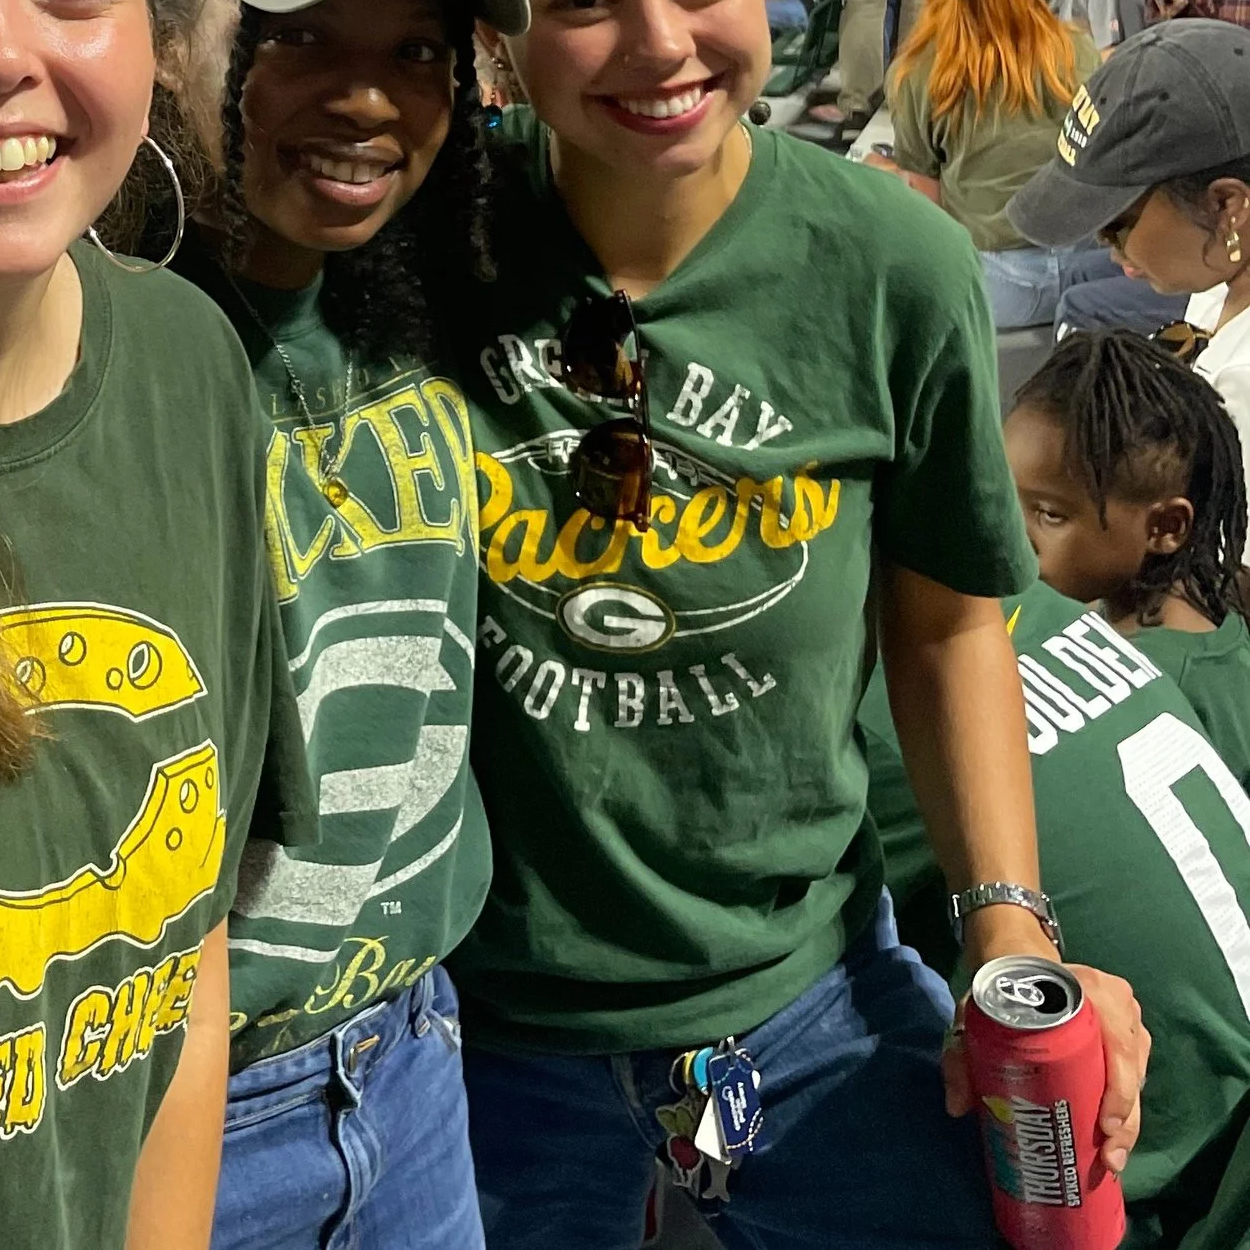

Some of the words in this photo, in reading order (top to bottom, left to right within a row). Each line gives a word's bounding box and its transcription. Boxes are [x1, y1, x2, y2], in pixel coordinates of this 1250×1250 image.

[666, 361, 793, 450] BAY
[477, 616, 777, 731] FOOTBALL
[380, 901, 402, 915] TM
[55, 942, 204, 1091] CHEE
[1011, 1095, 1063, 1205] THURSDAY
[1055, 1098, 1076, 1166] REFRESHERS
[1064, 1165, 1081, 1207] SPIKED
